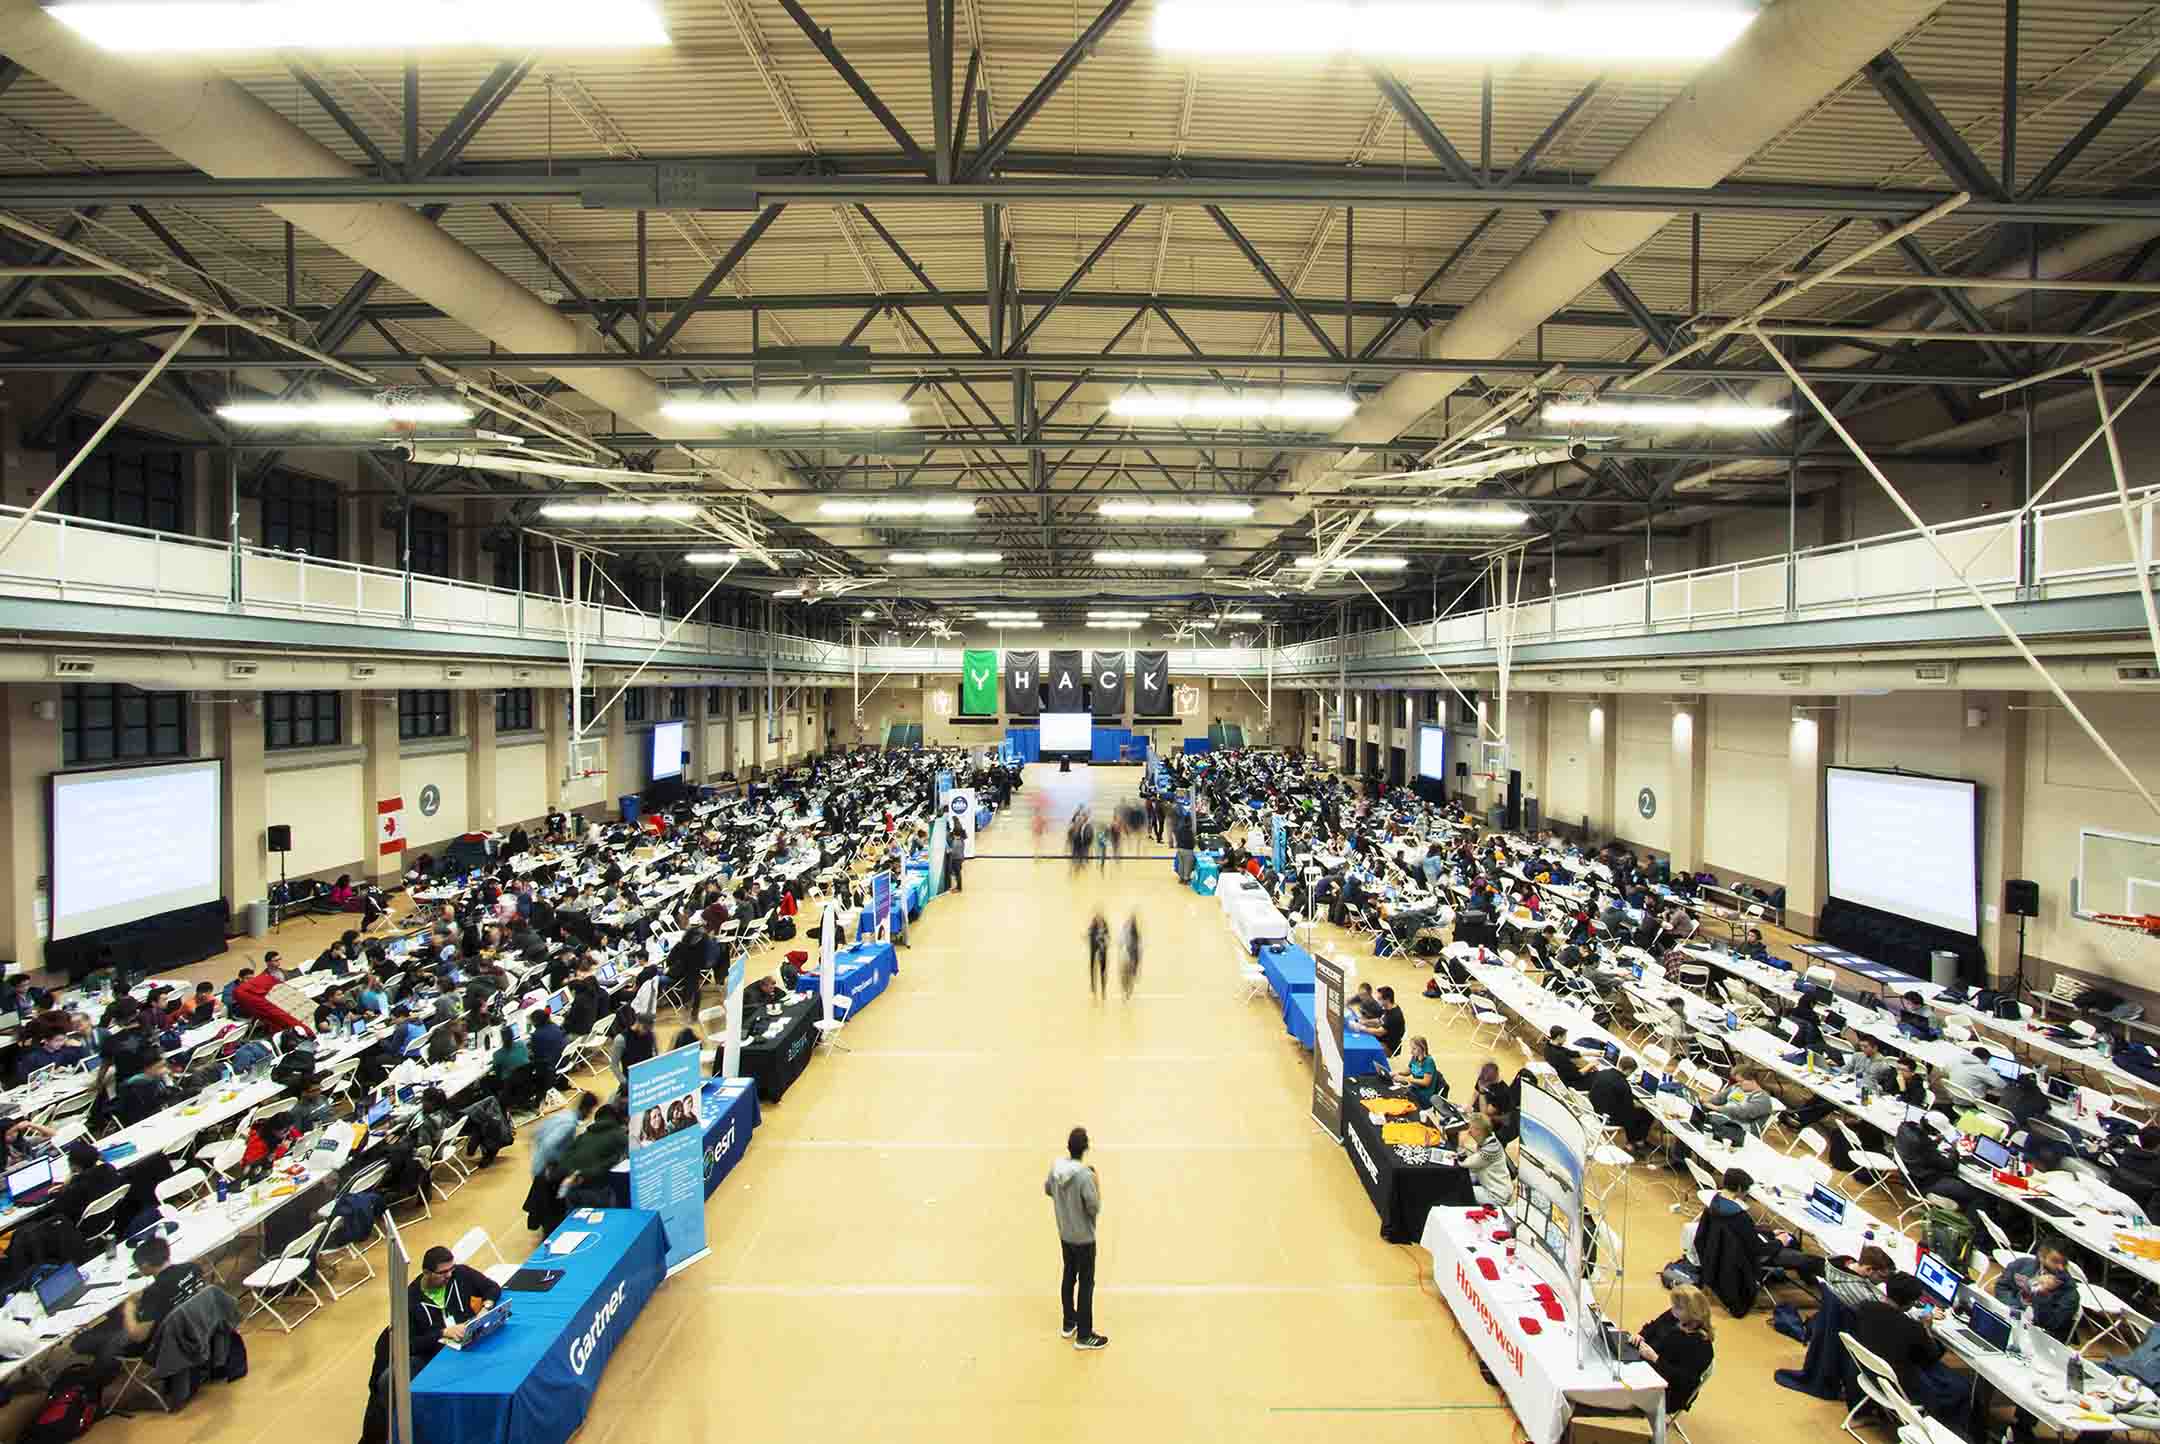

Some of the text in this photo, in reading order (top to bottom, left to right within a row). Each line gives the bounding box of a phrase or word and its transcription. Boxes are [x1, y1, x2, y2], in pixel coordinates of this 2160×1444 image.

[425, 791, 435, 811] 2
[1641, 794, 1651, 814] 2
[714, 1118, 735, 1162] esri
[1456, 1262, 1523, 1377] Honeywell
